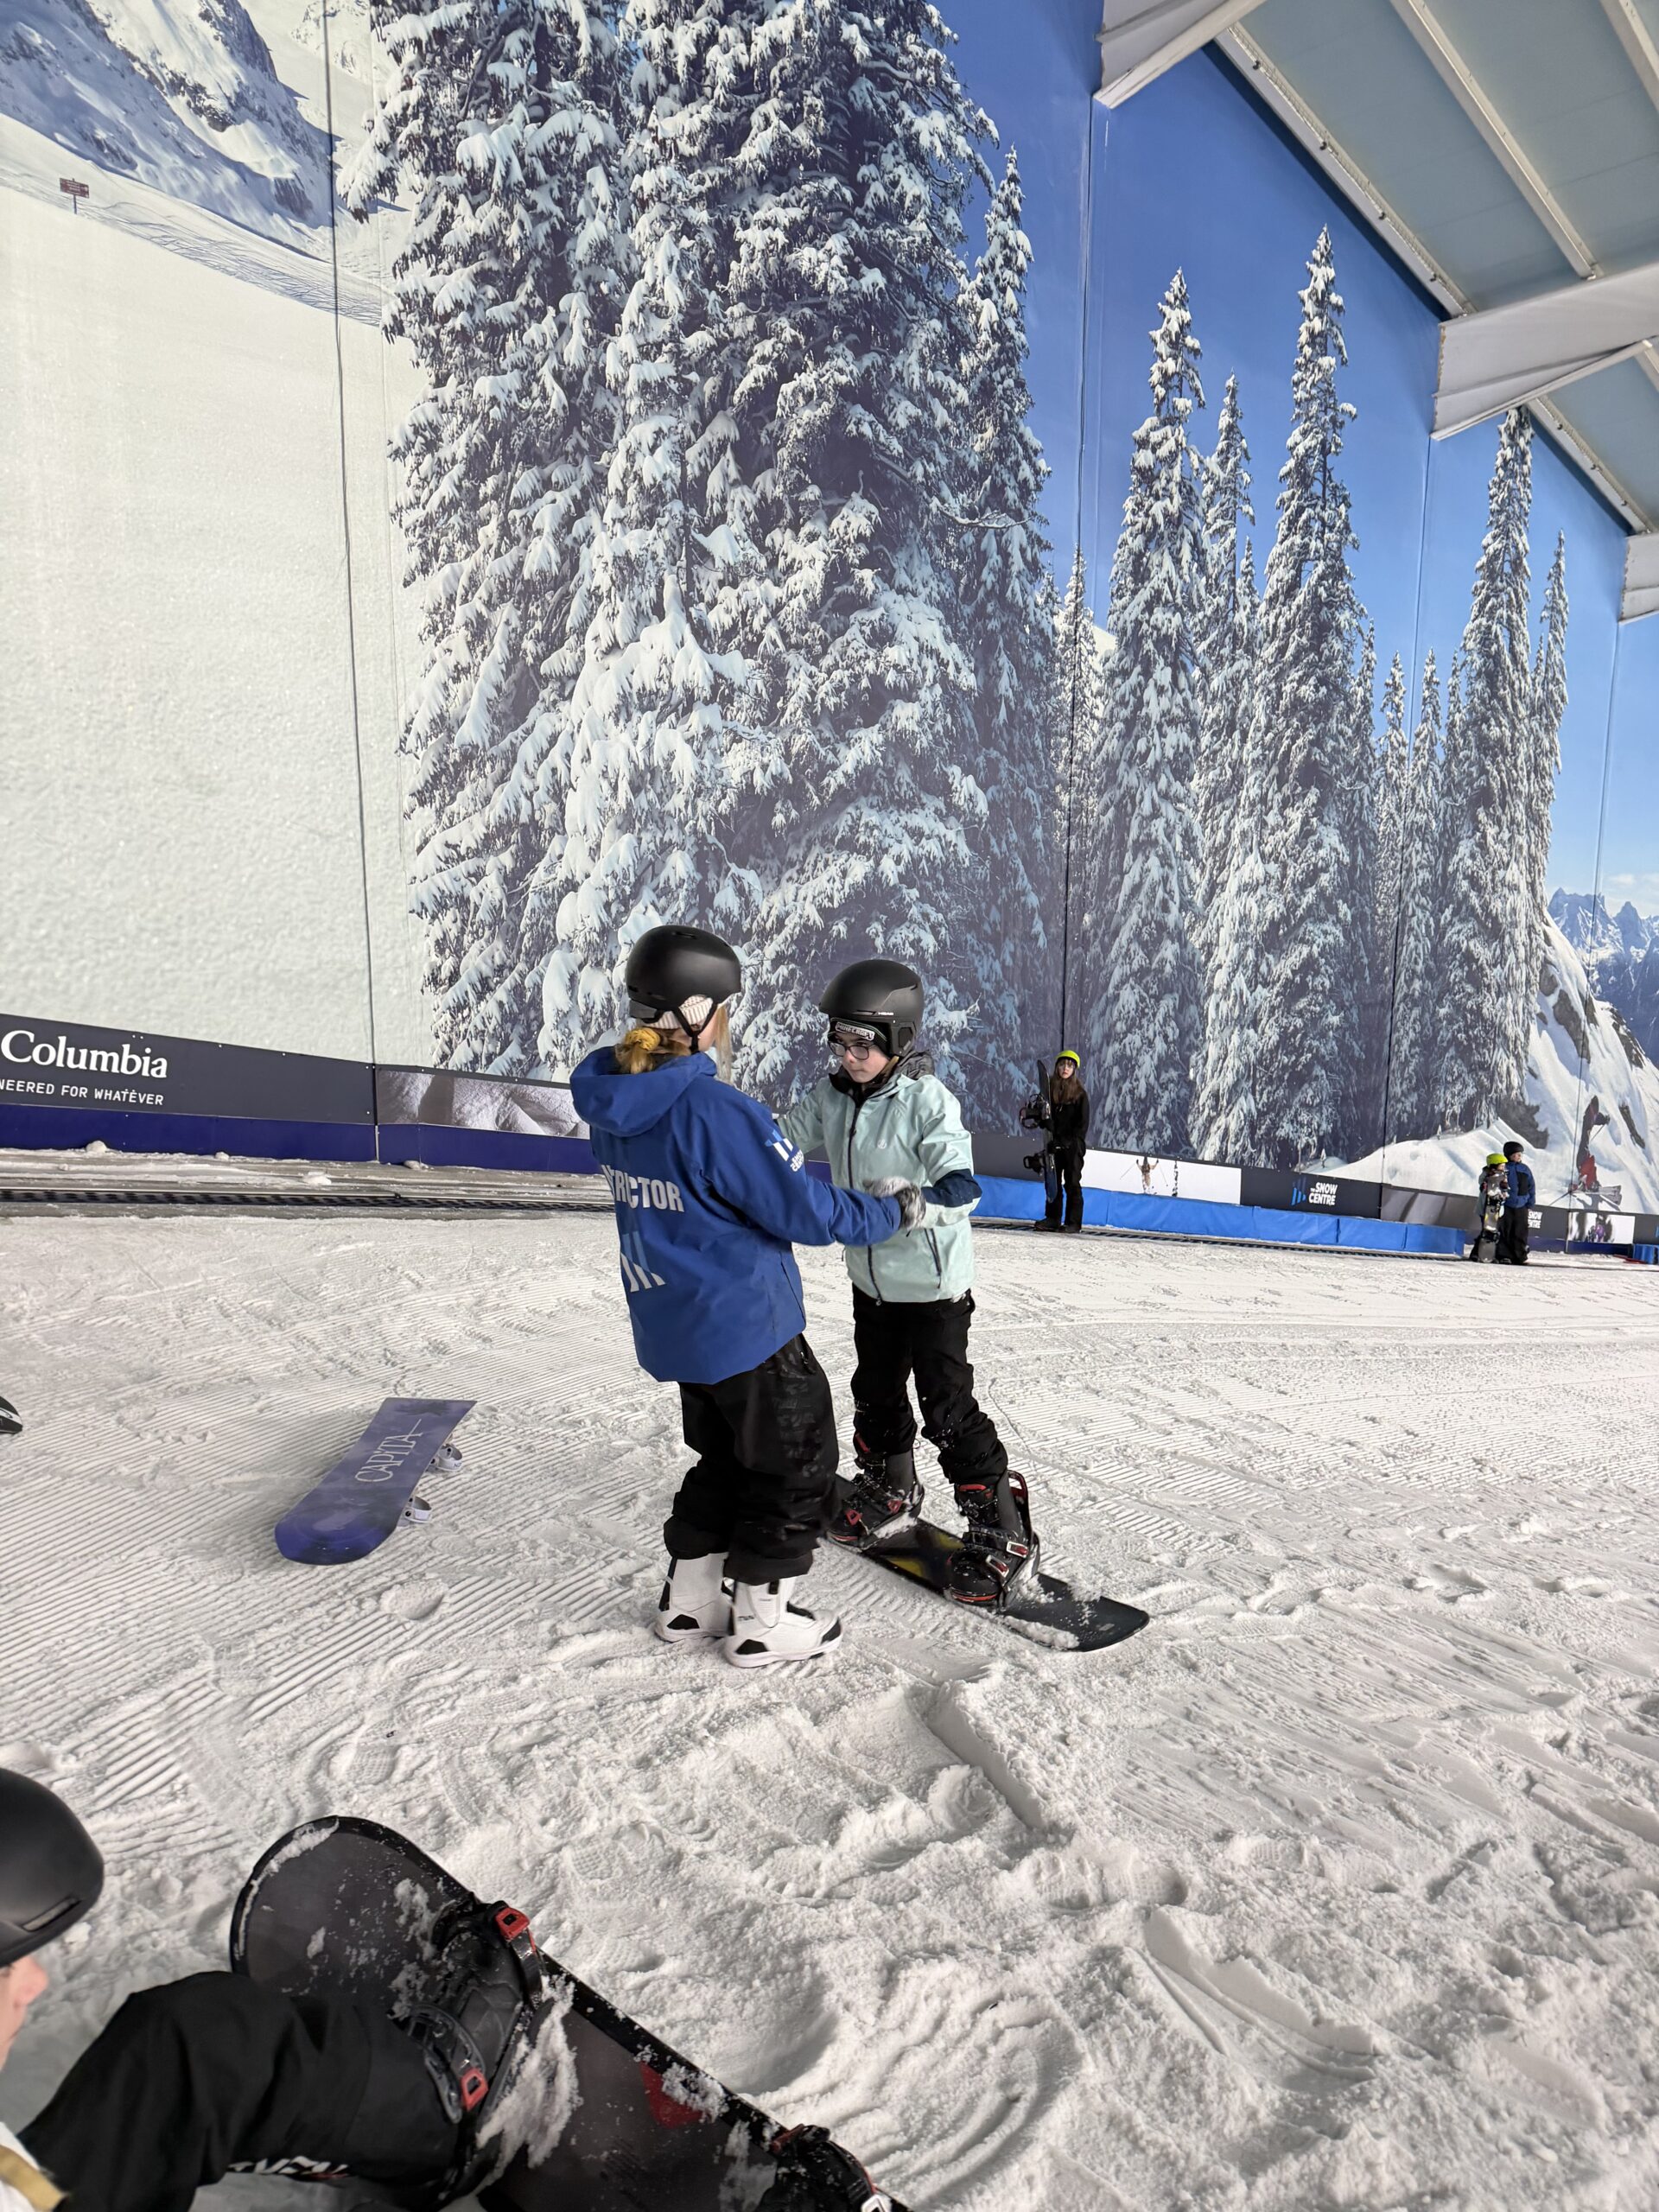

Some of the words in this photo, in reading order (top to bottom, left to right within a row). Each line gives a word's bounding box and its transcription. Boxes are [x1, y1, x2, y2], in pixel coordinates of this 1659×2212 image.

[1, 1030, 168, 1078] Columbia
[60, 1084, 88, 1098] FOR
[94, 1089, 164, 1106] WHATEVER
[1315, 1182, 1338, 1194] SNOW
[1308, 1192, 1337, 1206] CENTRE
